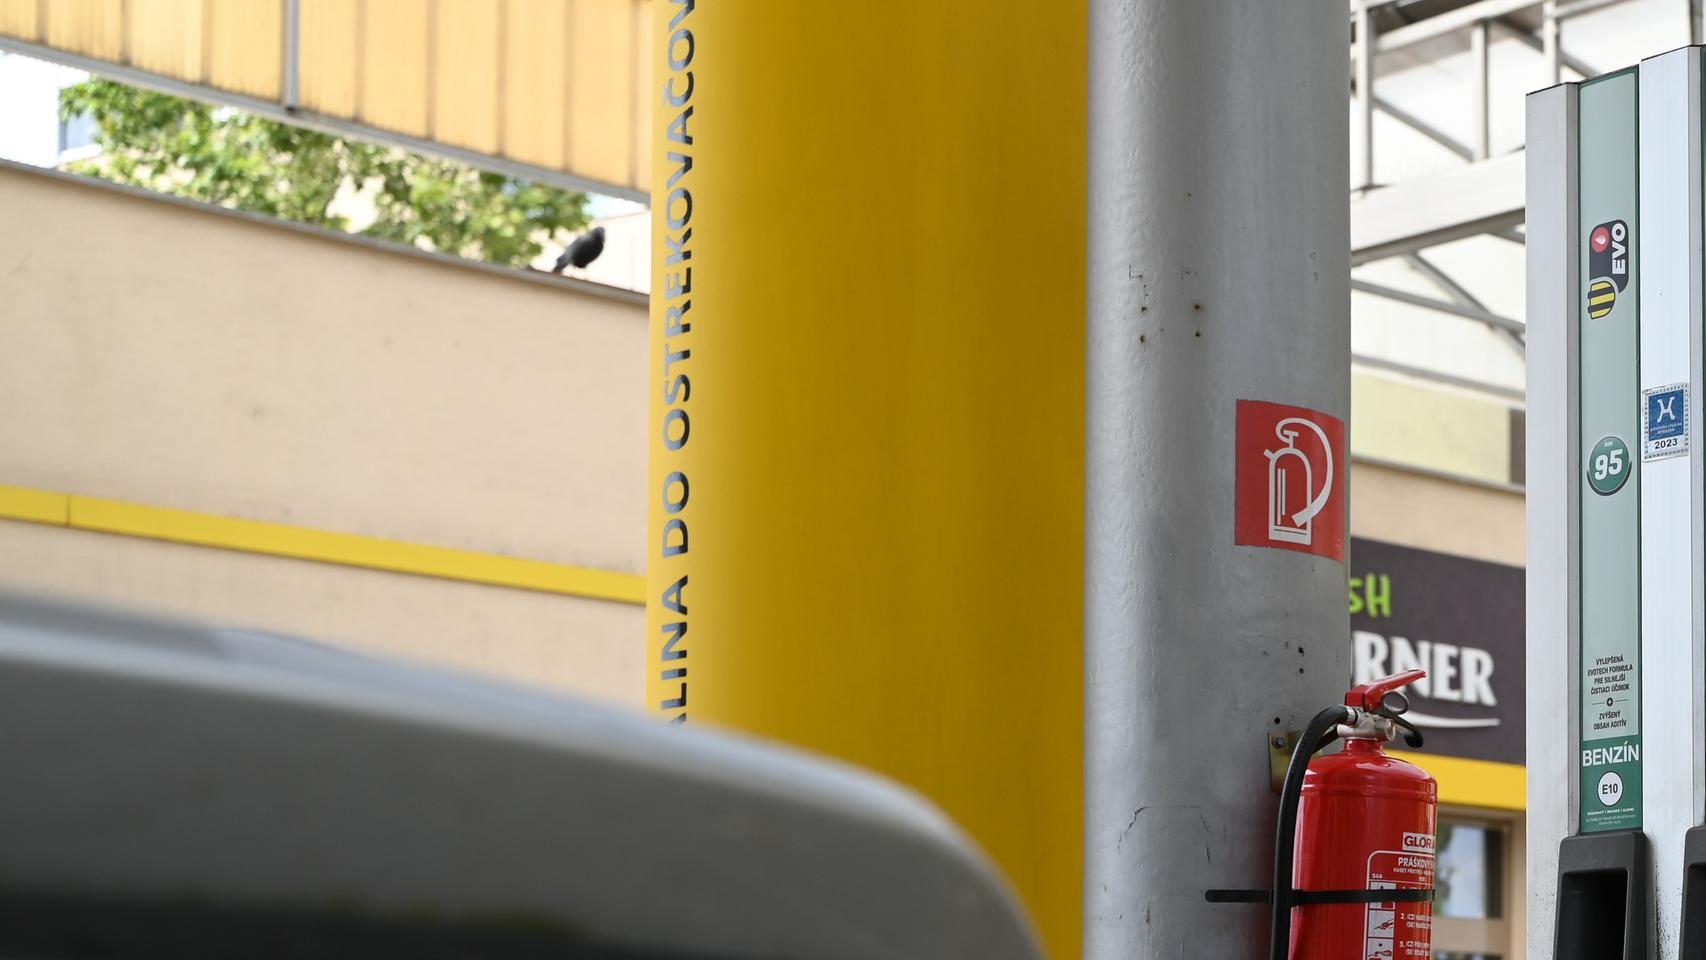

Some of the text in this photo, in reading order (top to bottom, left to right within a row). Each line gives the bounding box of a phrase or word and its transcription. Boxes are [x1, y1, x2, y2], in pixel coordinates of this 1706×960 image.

[1612, 222, 1626, 275] EVO
[661, 0, 695, 727] LINA DO OSTREKOVAČOV
[1654, 438, 1678, 450] 2023
[1595, 449, 1623, 480] 95
[1349, 630, 1497, 707] RNER
[1583, 741, 1639, 767] BENZÍN
[1602, 783, 1618, 794] E10
